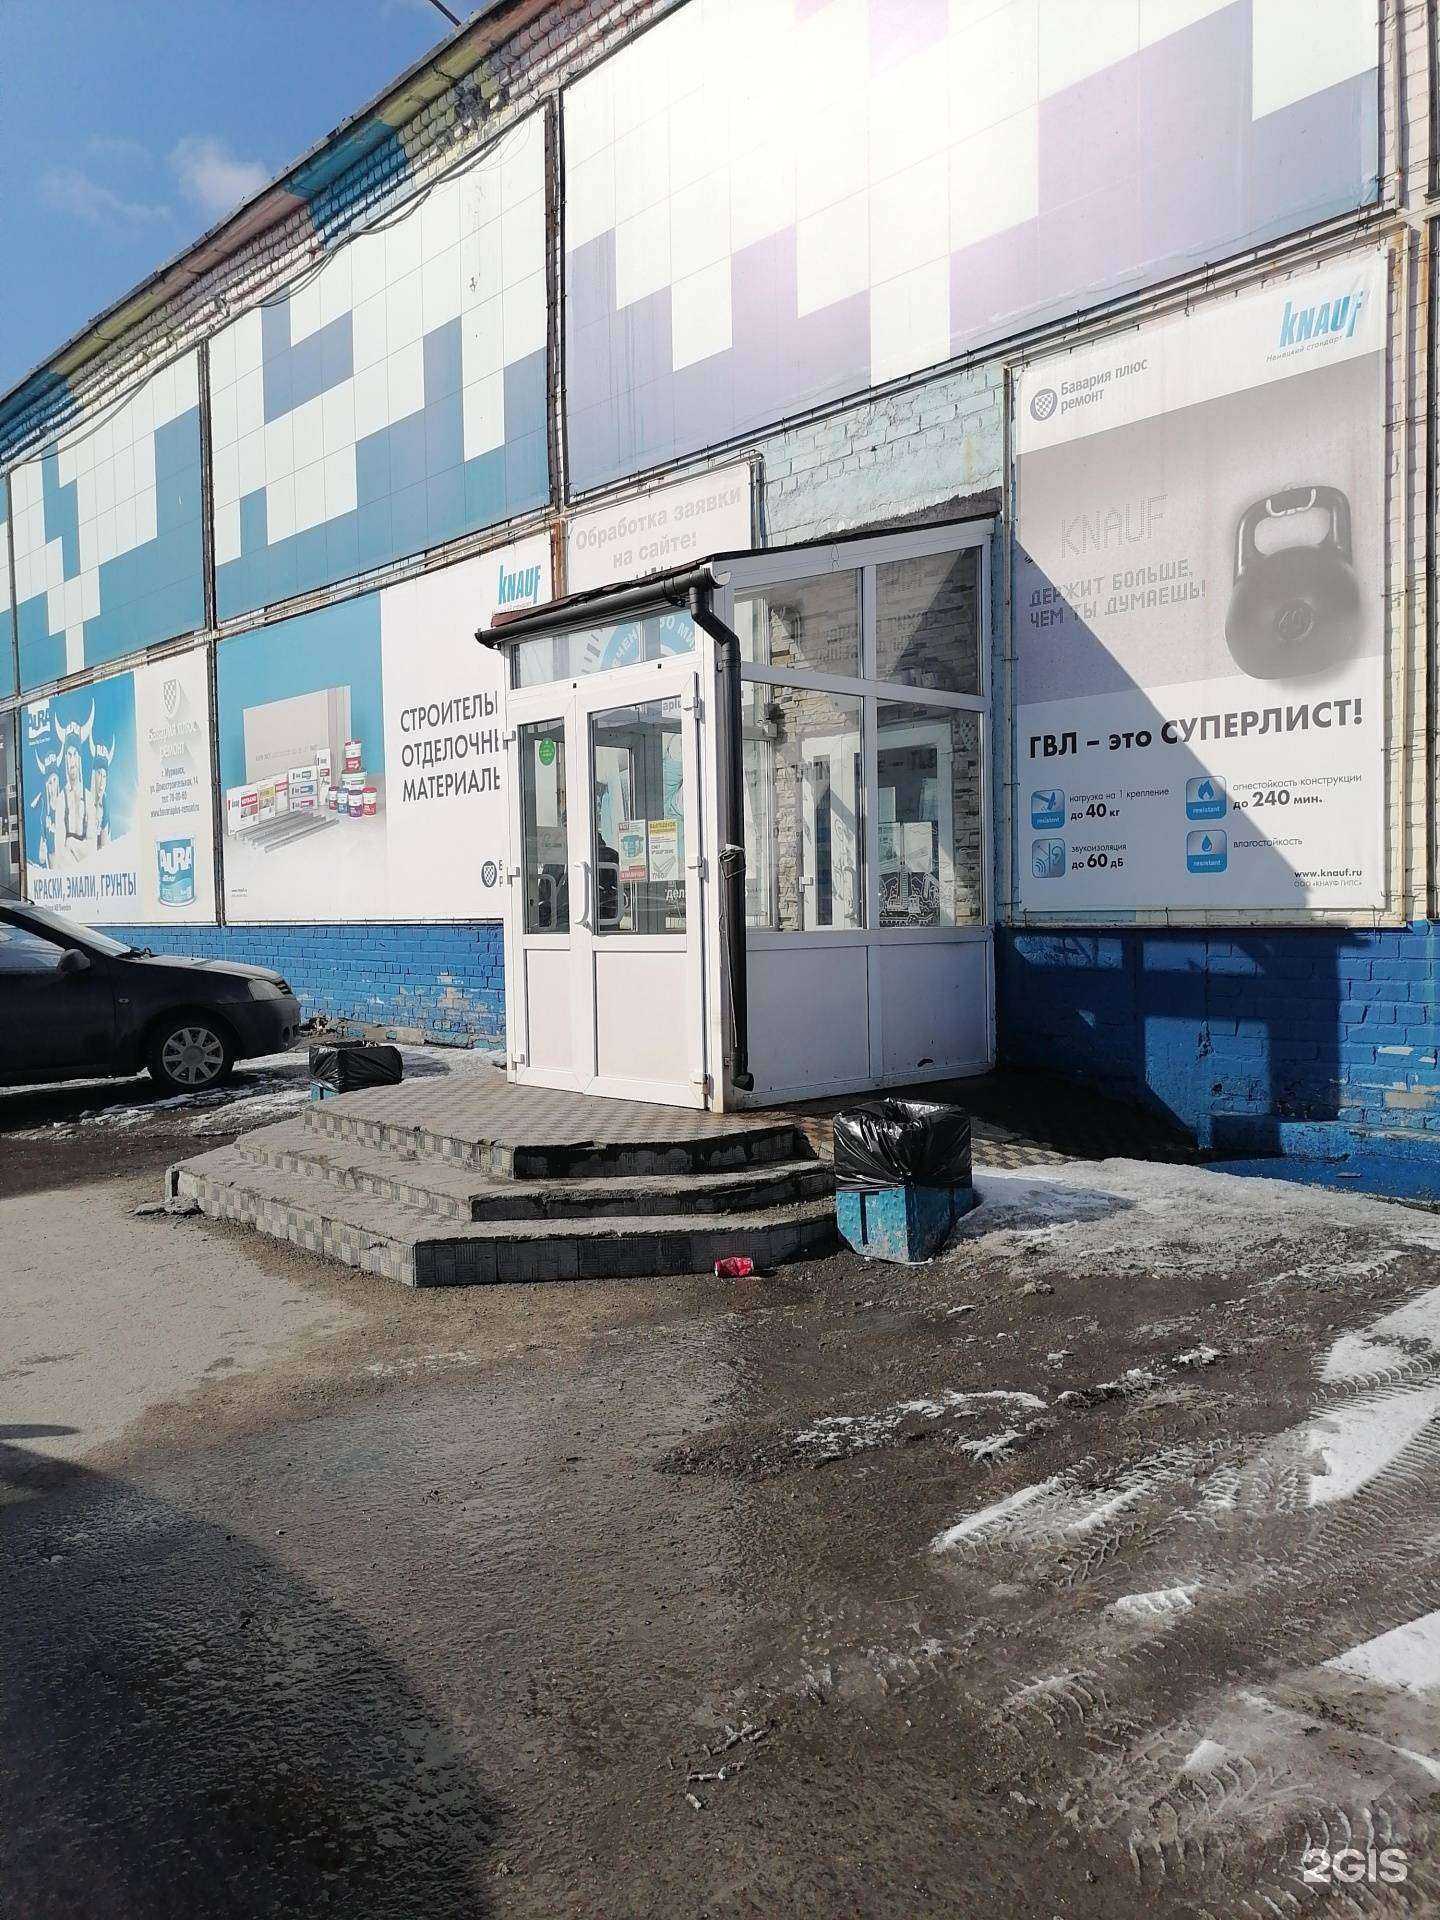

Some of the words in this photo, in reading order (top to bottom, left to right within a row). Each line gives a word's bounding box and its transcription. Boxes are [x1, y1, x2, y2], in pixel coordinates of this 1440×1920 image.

[1061, 370, 1112, 396] Бавария
[1115, 359, 1148, 379] плюс
[1061, 389, 1105, 415] ремонт
[575, 509, 668, 550] Обработка
[674, 487, 742, 522] заявки
[1060, 494, 1168, 559] KNAUF
[613, 552, 633, 569] на
[1030, 577, 1105, 608] ДЕРЖИТ
[1112, 558, 1193, 591] БОЛЬШЕ,
[1030, 607, 1064, 629] ЧЕМ
[1072, 600, 1097, 622] ТЫ
[1104, 579, 1206, 617] ДУМАЕШЬ!
[400, 690, 498, 733] СТРОИТЕЛЬ
[1030, 731, 1078, 759] ГВЛ
[1108, 729, 1152, 751] это
[1161, 698, 1363, 744] СУПЕРЛИСТ!
[1233, 780, 1298, 792] огнестойкость
[1300, 774, 1362, 788] конструкции
[1069, 793, 1105, 805] нагрузка
[1126, 787, 1170, 799] крепление
[1232, 800, 1249, 811] до
[1252, 789, 1291, 808] 240
[1293, 795, 1323, 805] мин.
[1070, 812, 1084, 821] до
[1086, 803, 1107, 818] 40
[1109, 808, 1121, 817] кг
[1071, 844, 1127, 855] звукоизоляция
[1233, 838, 1303, 849] влагостойкость
[1071, 861, 1085, 870] до
[1087, 853, 1108, 868] 60
[1110, 858, 1124, 869] дБ
[1294, 868, 1362, 878] www.knauf.ru
[33, 877, 65, 902] КРАСКИ,
[66, 875, 99, 901] ЭМАЛИ,
[100, 872, 137, 897] ГРУНТЫ
